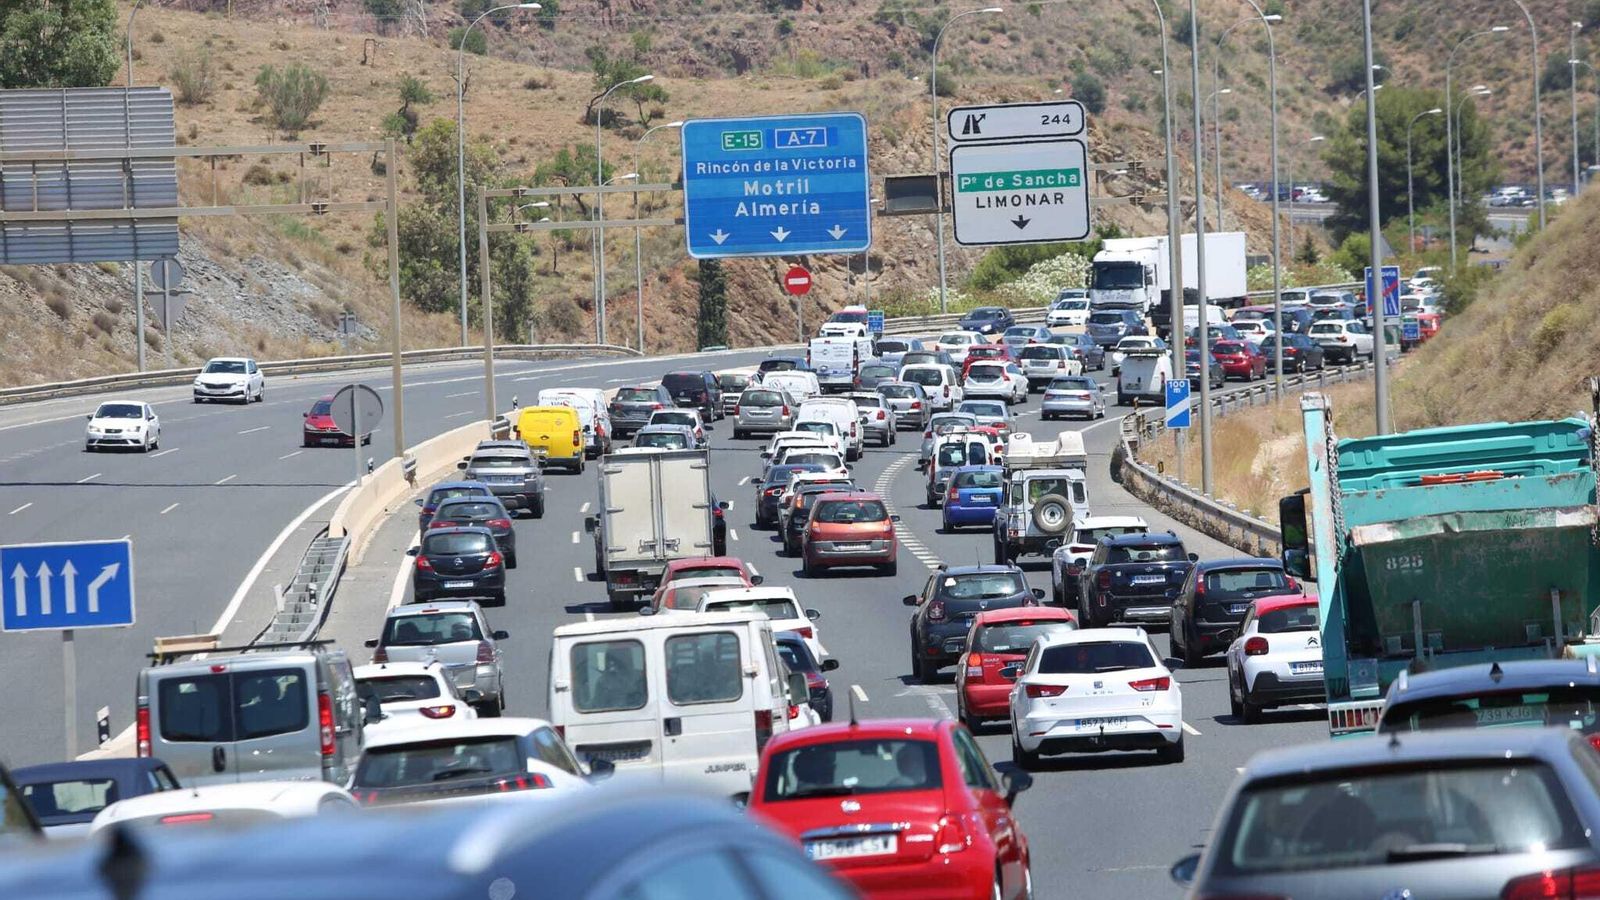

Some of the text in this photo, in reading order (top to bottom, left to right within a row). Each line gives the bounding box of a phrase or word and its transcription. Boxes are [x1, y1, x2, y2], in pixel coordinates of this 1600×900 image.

[1041, 114, 1071, 125] 244
[725, 134, 760, 147] E-15
[788, 131, 817, 145] A-7
[696, 157, 856, 174] Rincón de la Victoria
[744, 178, 810, 196] Motril
[985, 176, 1004, 188] de
[1012, 173, 1078, 187] Sancha
[976, 192, 1065, 208] LIMONAR
[735, 200, 820, 217] Almería
[1169, 381, 1185, 389] 100
[1386, 555, 1423, 570] 825
